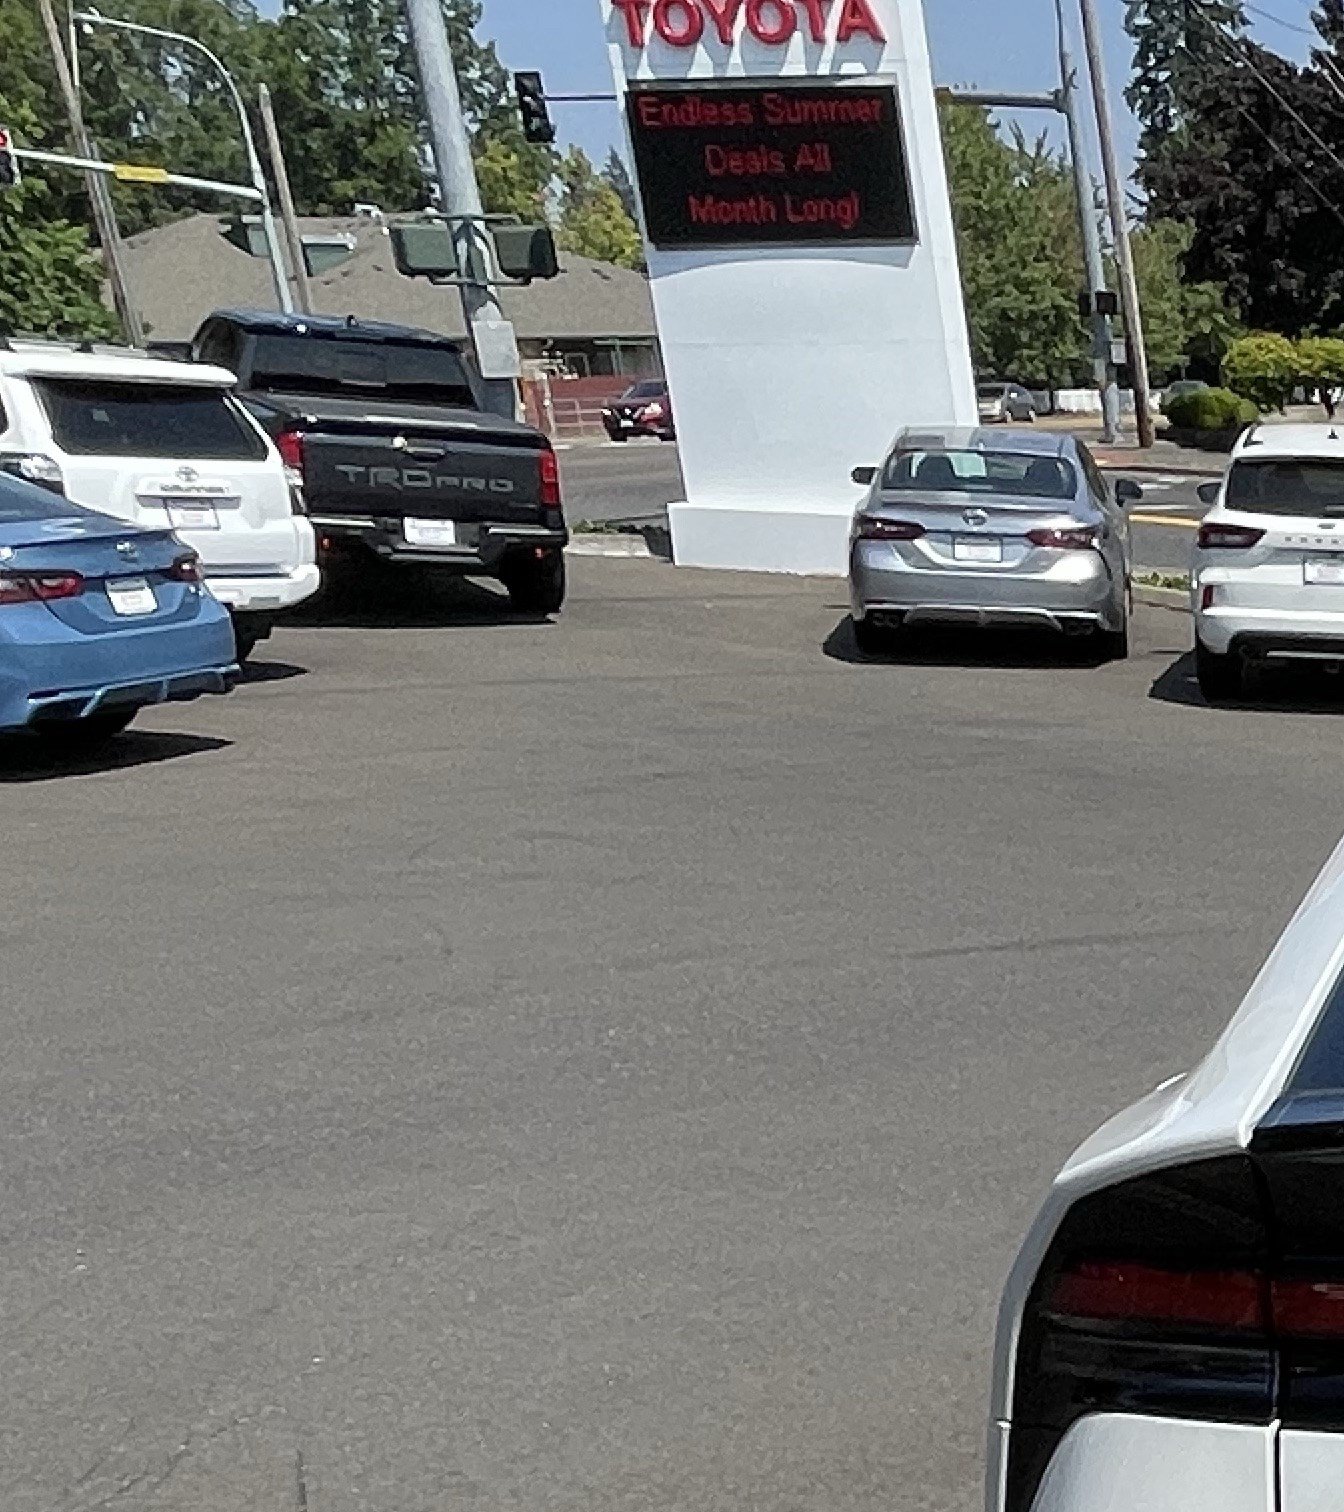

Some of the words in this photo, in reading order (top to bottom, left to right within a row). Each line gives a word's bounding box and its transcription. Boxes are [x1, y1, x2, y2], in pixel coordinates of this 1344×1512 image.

[611, 0, 887, 48] TOYOTA
[638, 96, 753, 127] Endless
[762, 93, 884, 125] Summer
[704, 144, 785, 175] Deals
[795, 143, 833, 172] All
[688, 195, 776, 225] Month
[785, 191, 861, 230] Long!
[335, 464, 433, 491] TRD
[436, 476, 514, 492] PRO
